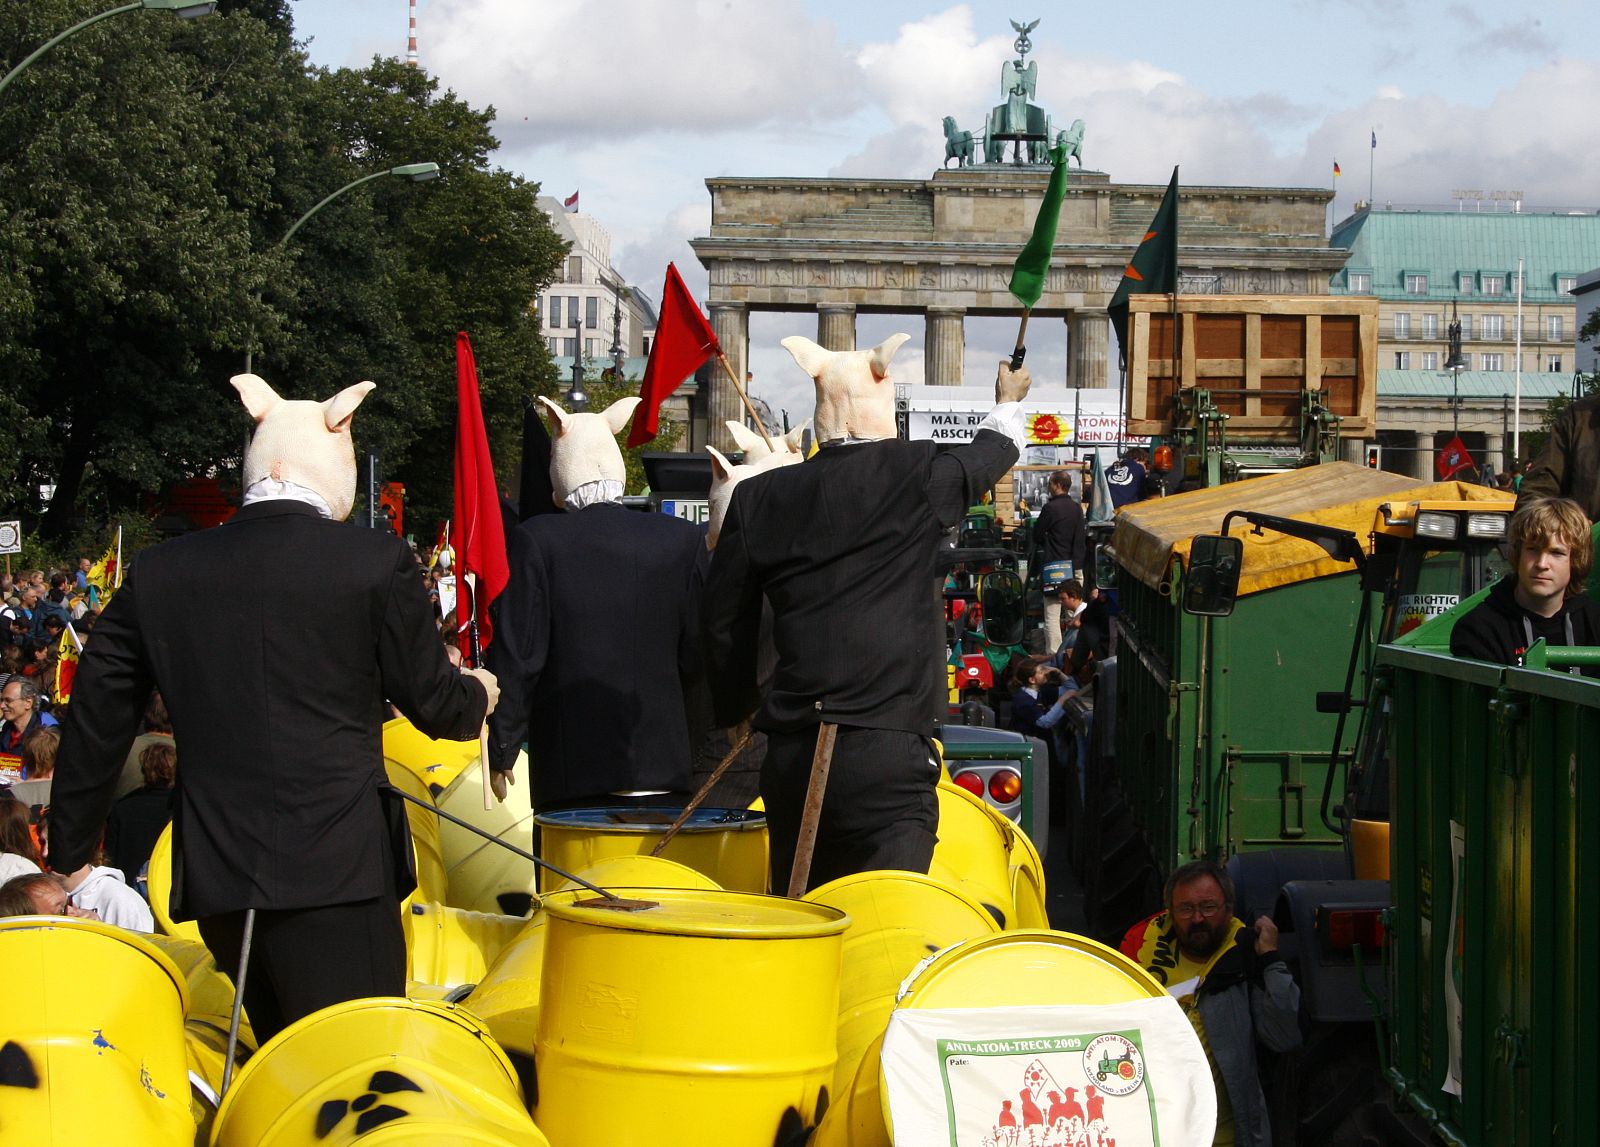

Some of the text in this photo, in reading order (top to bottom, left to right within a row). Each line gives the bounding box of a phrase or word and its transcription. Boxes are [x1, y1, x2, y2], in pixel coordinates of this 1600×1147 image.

[931, 415, 960, 425] MAL
[1076, 431, 1101, 441] NEIN
[1414, 595, 1458, 606] RICHTIG
[946, 1038, 1082, 1052] ANTI-ATOM-TRECK 2009
[1086, 1036, 1137, 1060] ANTI-ATOM-TRECK
